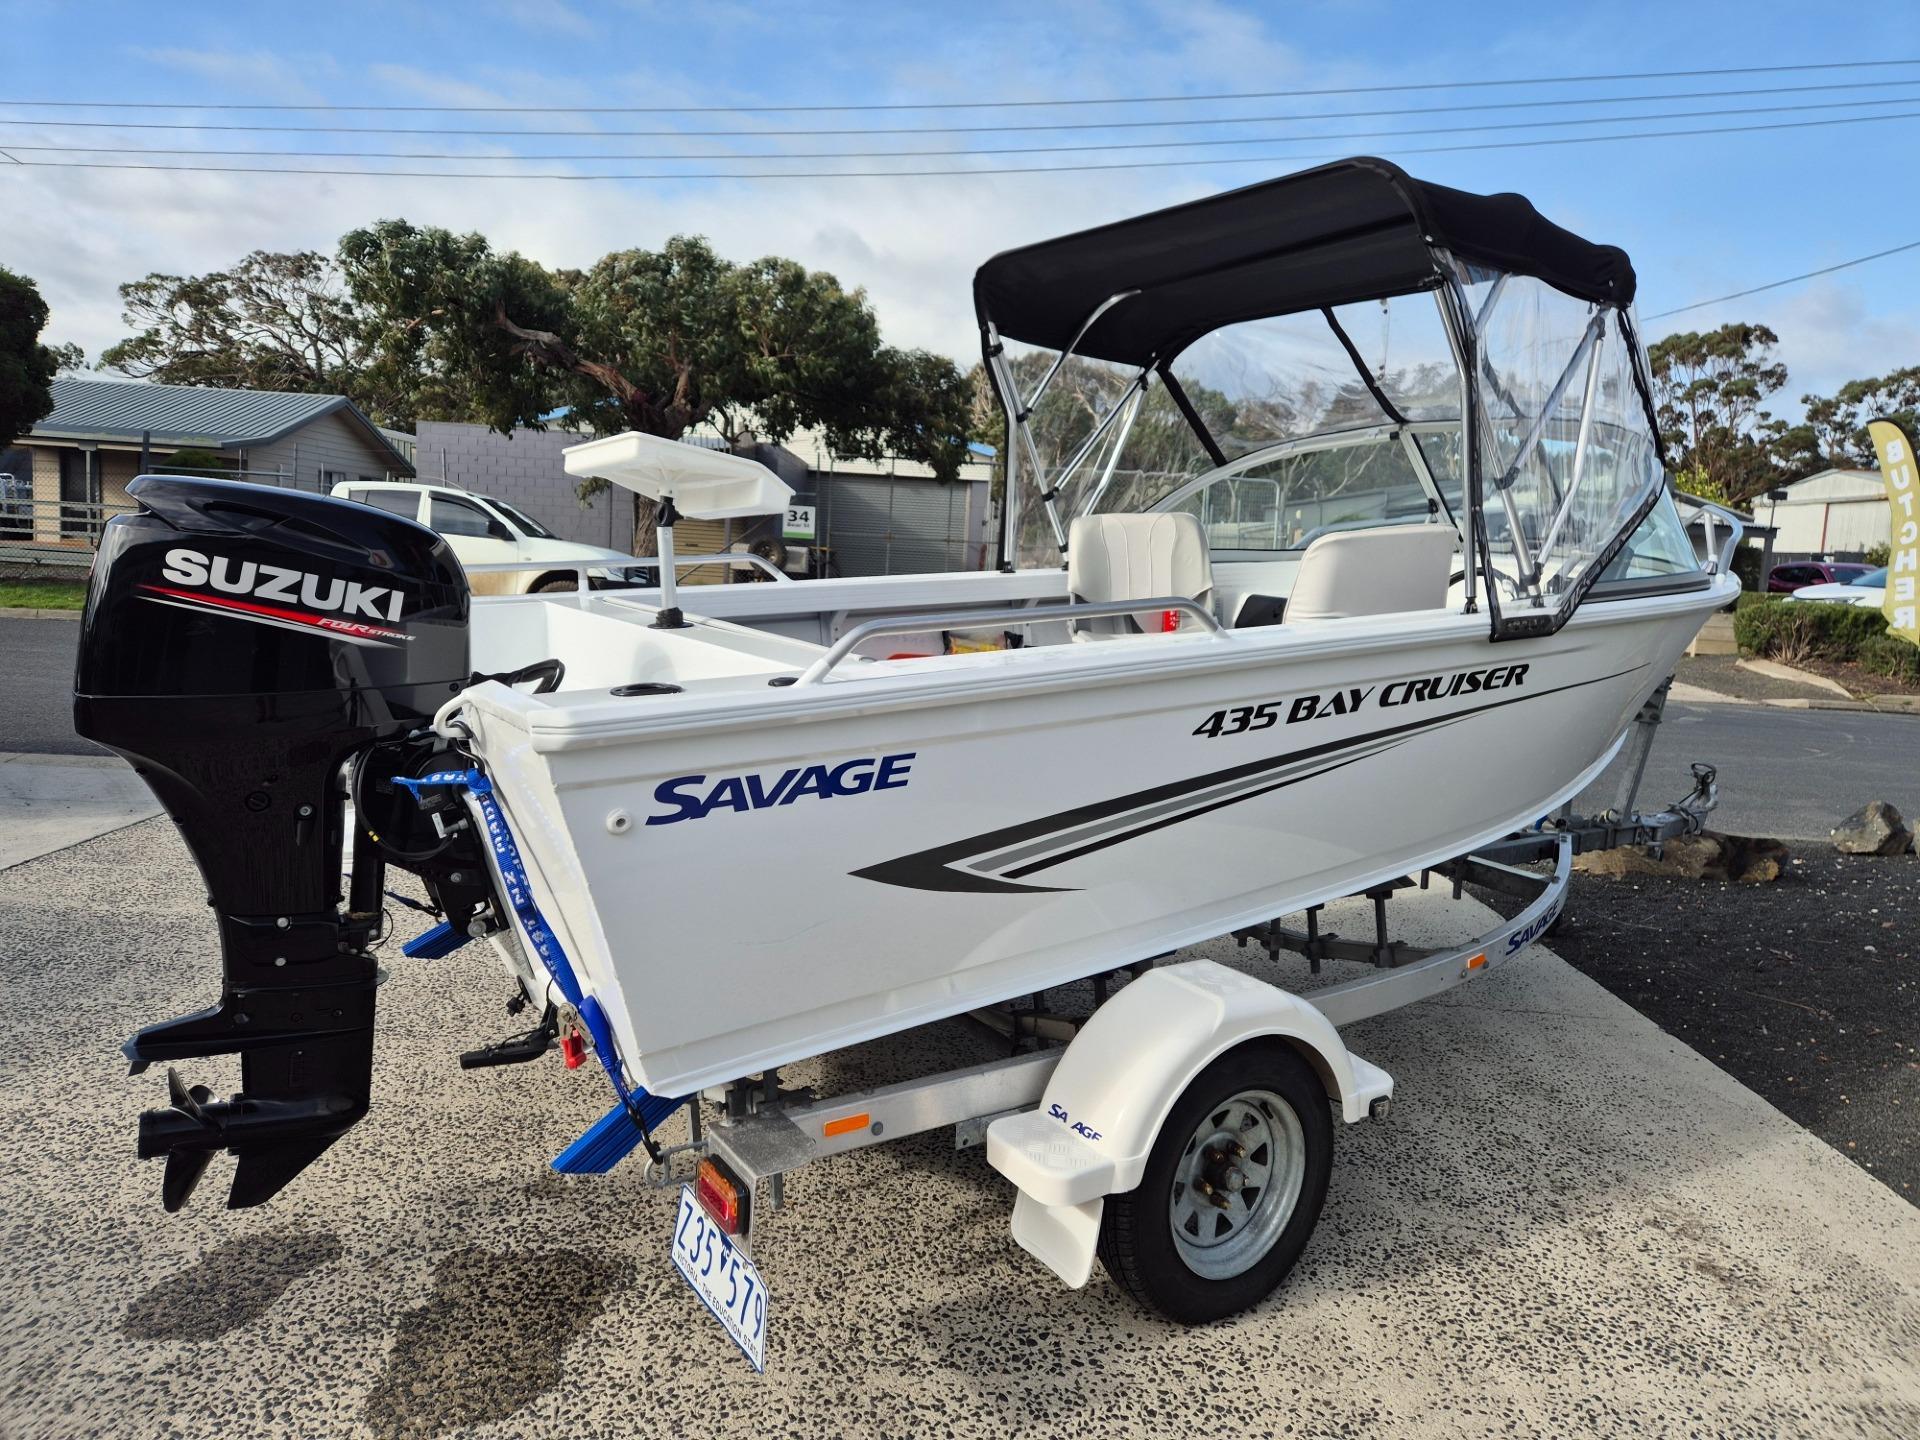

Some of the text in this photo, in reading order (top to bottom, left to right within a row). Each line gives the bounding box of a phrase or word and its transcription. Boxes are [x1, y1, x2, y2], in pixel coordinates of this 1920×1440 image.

[788, 510, 809, 522] 34
[162, 548, 405, 622] SUZUKI
[317, 618, 416, 641] FOUR STROKE
[1192, 663, 1530, 738] 435 BAY CRUISER
[645, 752, 916, 826] SAVAGE
[1505, 899, 1559, 955] SAVAGE
[677, 1200, 762, 1339] Z35 579
[677, 1251, 698, 1286] VICTORIA
[702, 1283, 712, 1302] THE
[713, 1296, 742, 1341] EDUCATION
